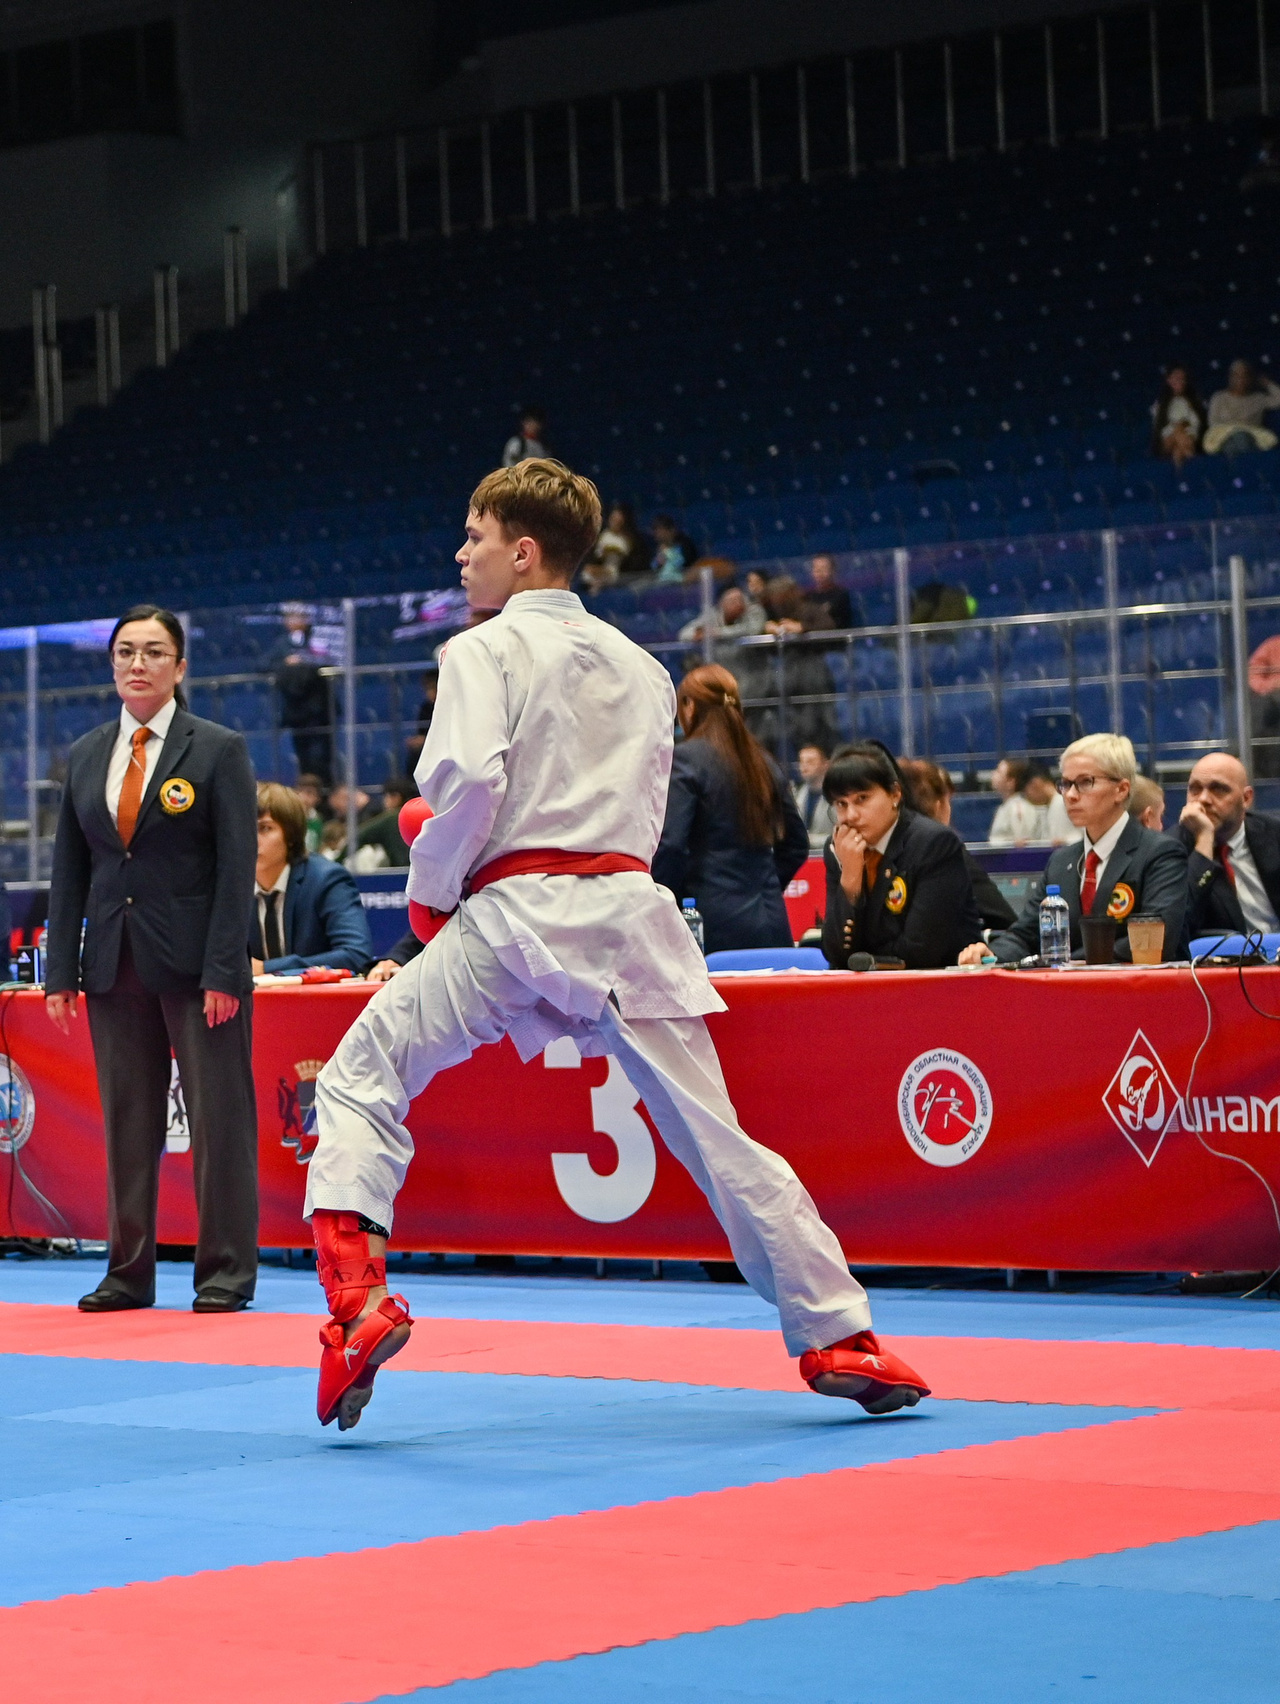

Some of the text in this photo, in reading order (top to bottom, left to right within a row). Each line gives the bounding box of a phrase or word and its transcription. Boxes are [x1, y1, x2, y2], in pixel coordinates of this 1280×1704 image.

[544, 1035, 657, 1224] 3
[901, 1052, 988, 1155] НОВОСИБИРСКАЯ ОБЛАСТНАЯ ФЕДЕРАЦИЯ КАРАТЭ
